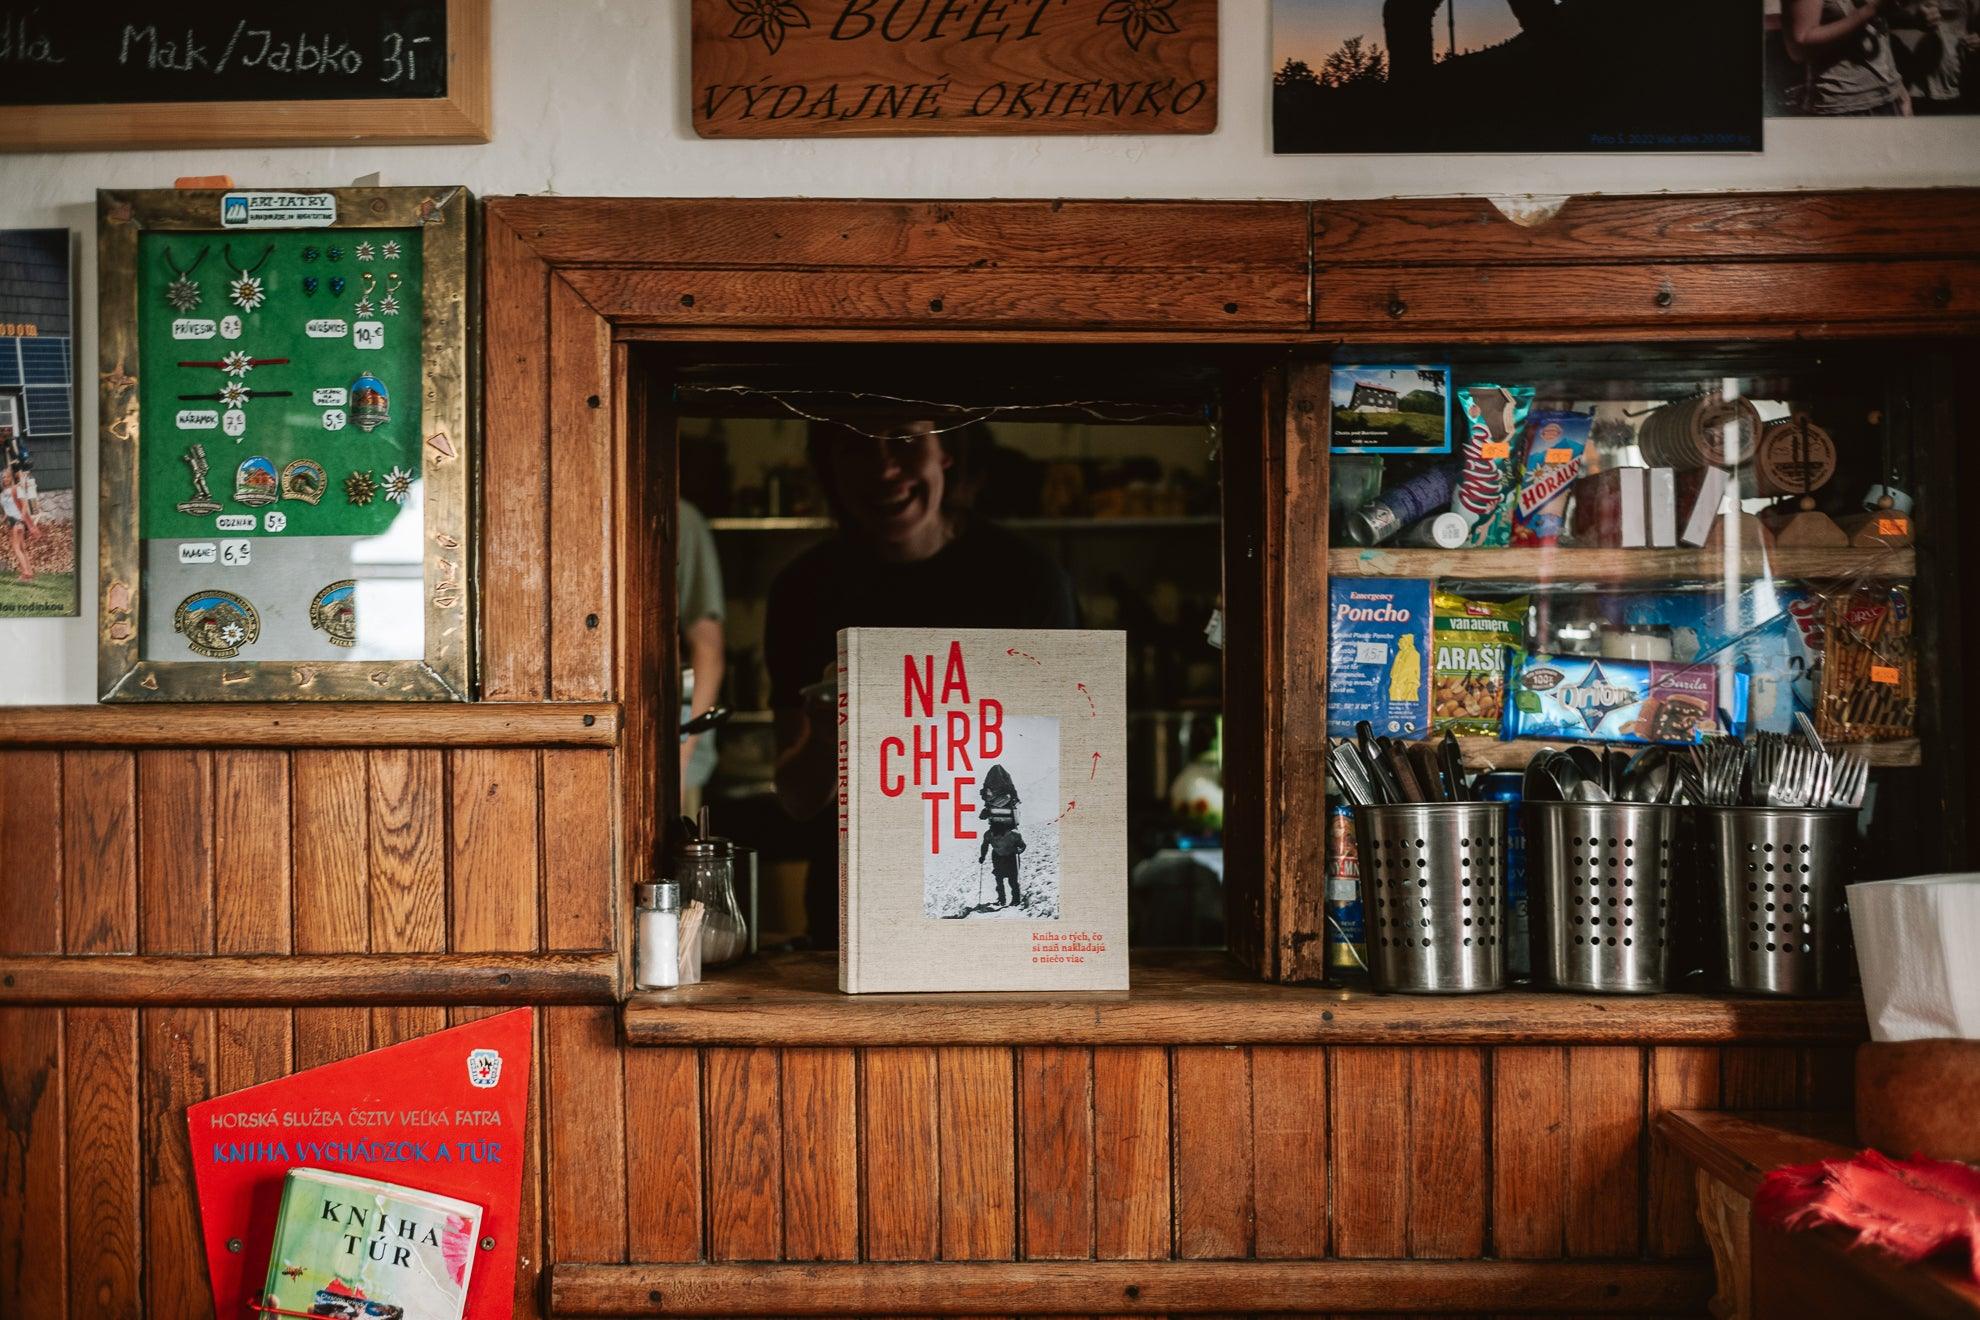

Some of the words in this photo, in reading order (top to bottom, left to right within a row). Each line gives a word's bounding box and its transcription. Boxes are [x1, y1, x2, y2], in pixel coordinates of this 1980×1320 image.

[702, 74, 949, 120] VÝDAJNÉ
[967, 78, 1207, 119] OKIENKO
[1521, 458, 1582, 509] HORALKY
[17, 602, 64, 611] rodinkou
[1350, 592, 1395, 601] Emergency
[1337, 603, 1410, 622] Poncho
[904, 640, 971, 718] NA
[1032, 932, 1059, 941] Kniha
[1069, 932, 1091, 942] tých,
[1092, 932, 1103, 941] čo
[1032, 943, 1040, 952] si
[1061, 943, 1106, 953] nakladajú
[1040, 954, 1064, 963] niečo
[1065, 954, 1085, 963] viac
[211, 1108, 279, 1128] HORSKÁ
[283, 1107, 343, 1127] SLUŽBA
[349, 1107, 394, 1127] ČSZTV
[400, 1106, 450, 1127] VEĽKÁ
[455, 1110, 502, 1126] FATRA
[213, 1142, 289, 1163] KNIHA
[296, 1136, 430, 1163] VYCHÁDZOK
[435, 1143, 452, 1162] A
[456, 1138, 502, 1163] TÚR
[321, 1199, 440, 1247] KNIHA
[344, 1234, 412, 1268] TÚR
